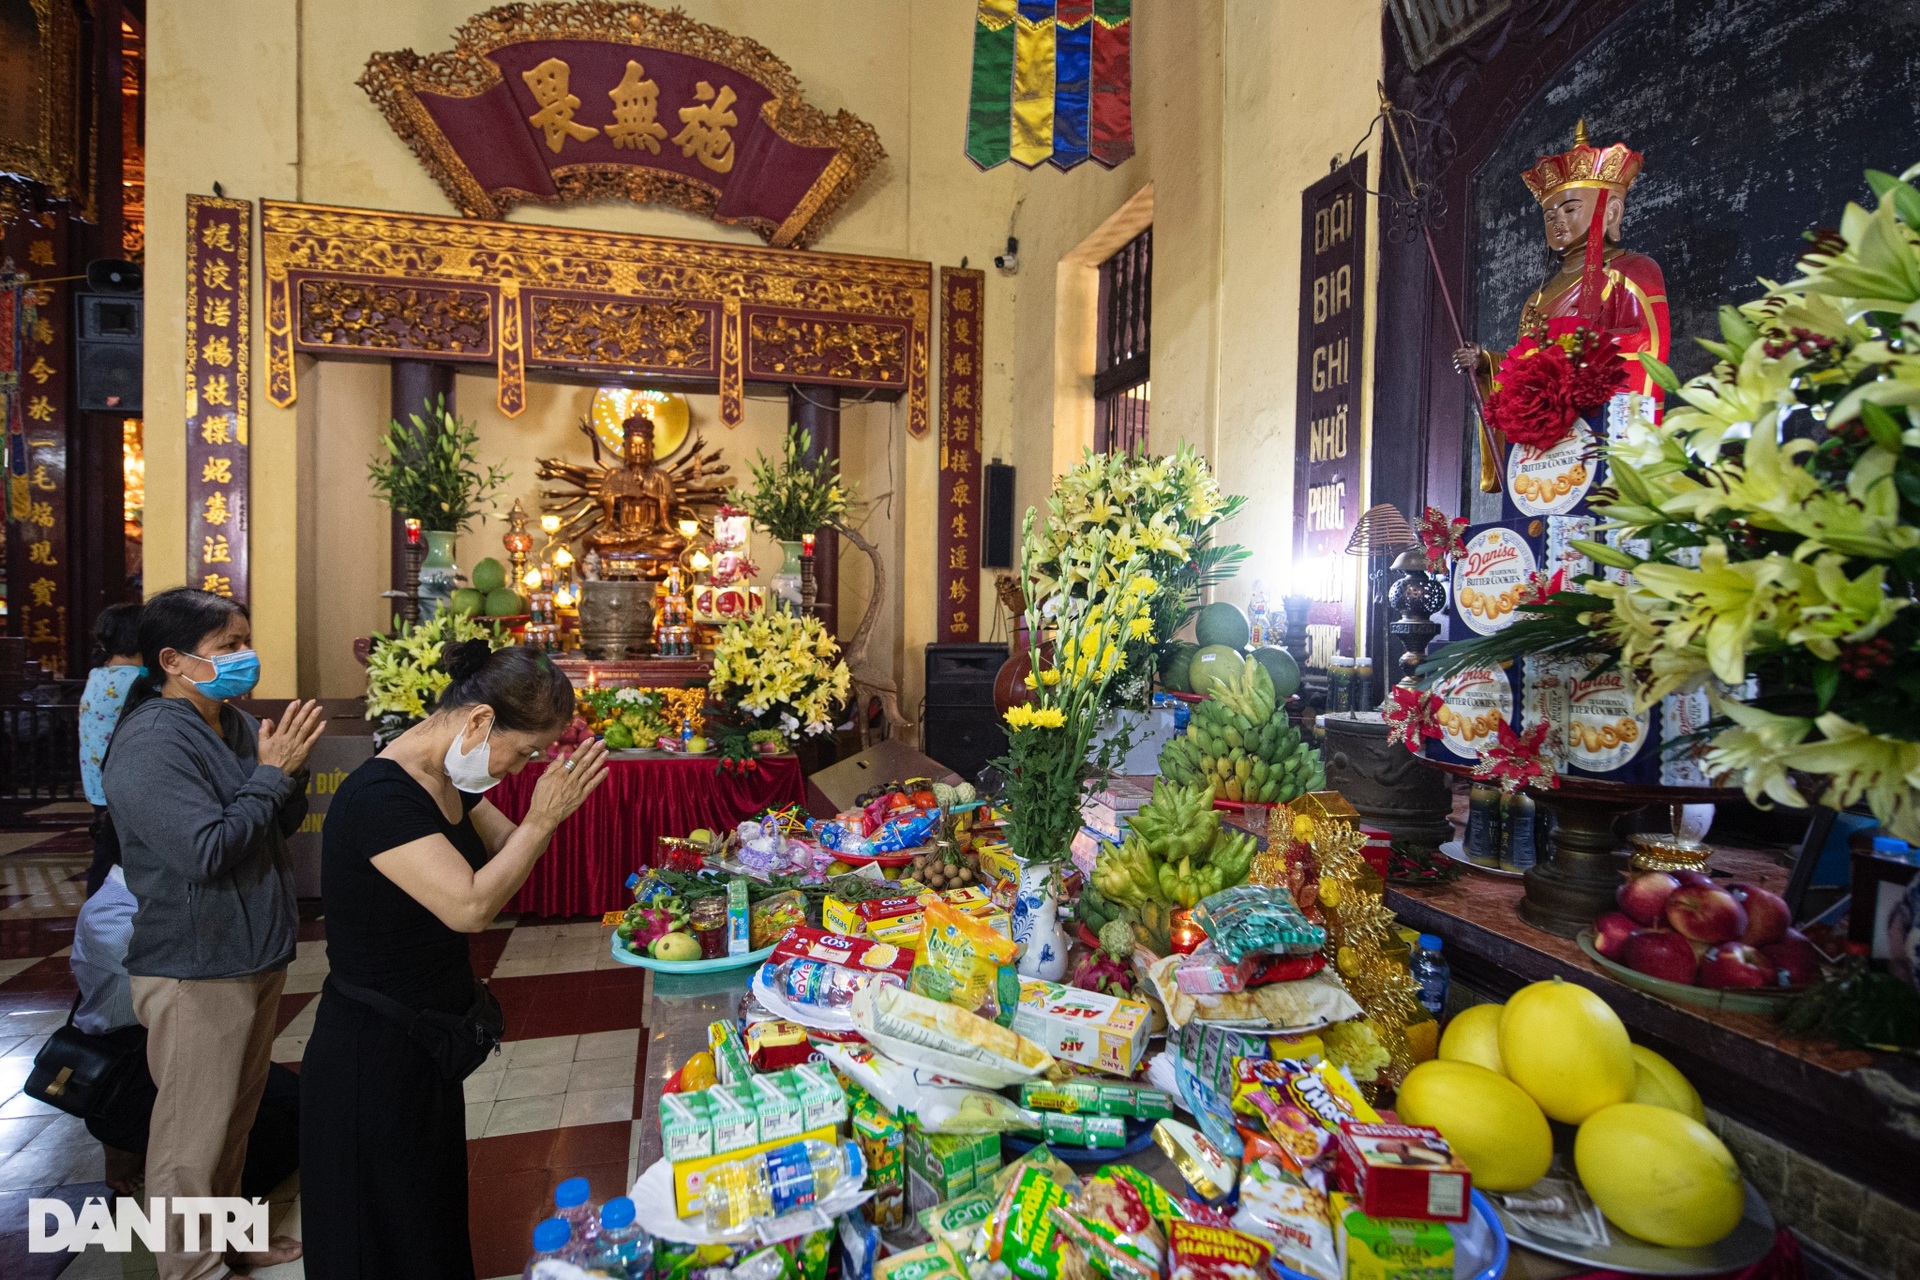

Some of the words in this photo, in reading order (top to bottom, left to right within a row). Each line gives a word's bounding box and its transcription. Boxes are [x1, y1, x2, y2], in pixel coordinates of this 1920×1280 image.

[1465, 543, 1518, 577] Danisa
[1466, 577, 1491, 587] BUTTER
[1491, 575, 1521, 585] COOKIES
[881, 898, 908, 907] COSY
[826, 909, 848, 931] Custas
[820, 935, 854, 949] COSY
[1049, 1005, 1103, 1019] AFC
[1060, 1041, 1085, 1052] AFC
